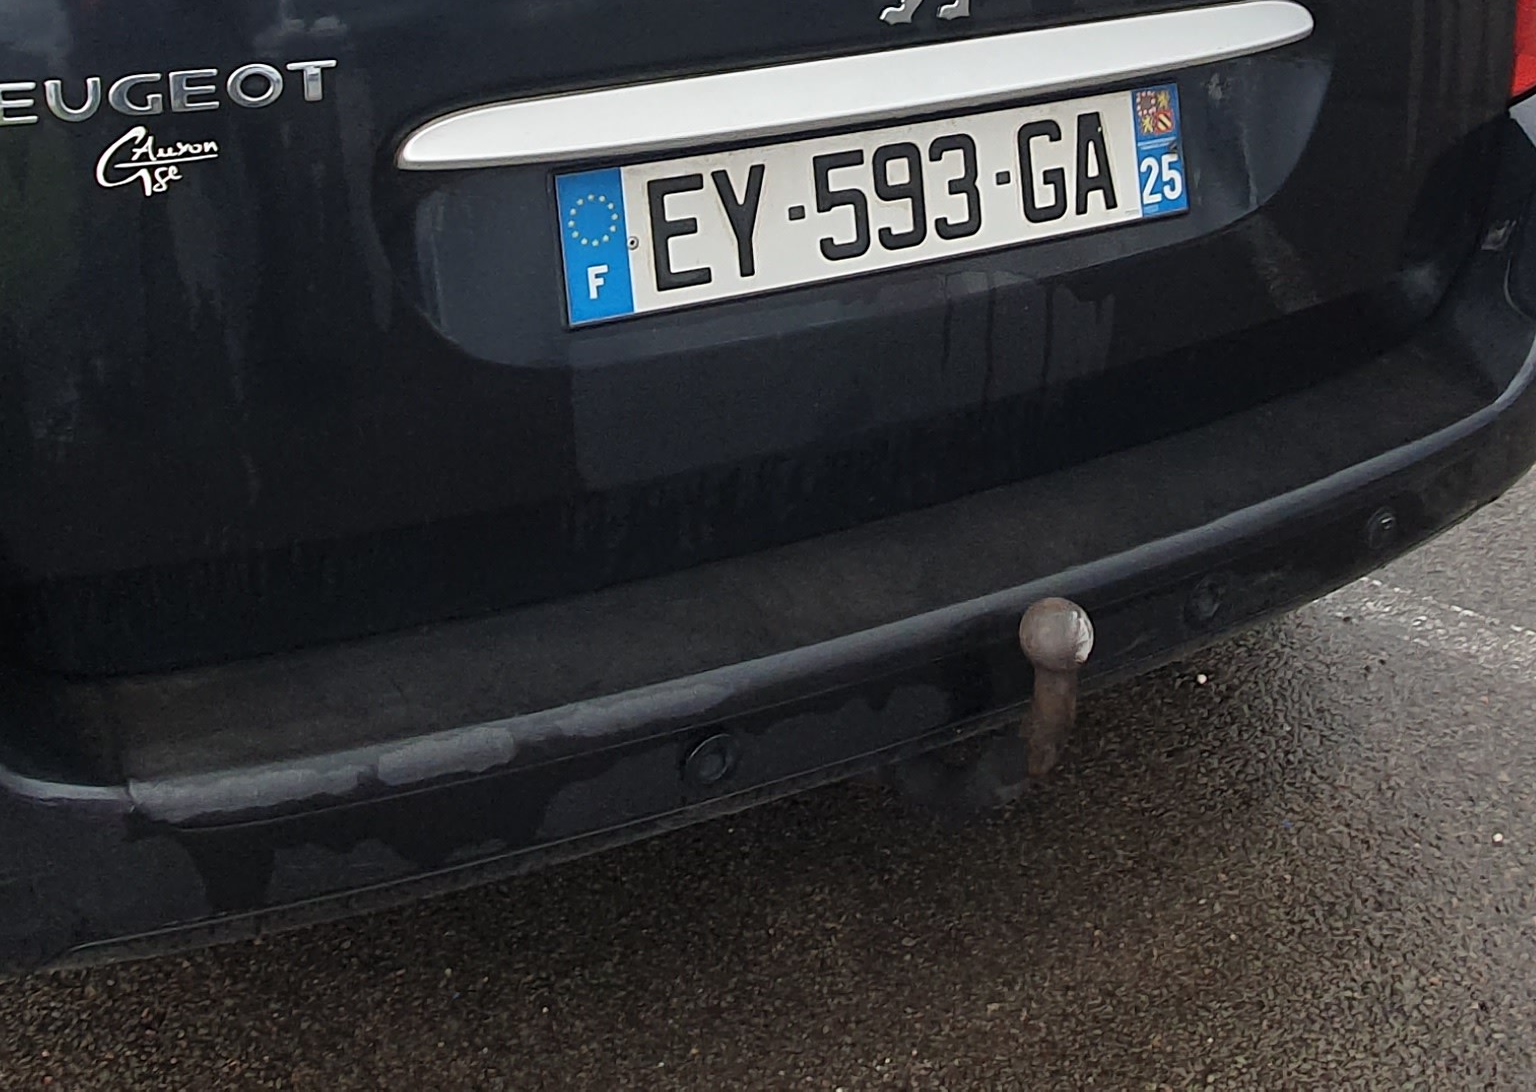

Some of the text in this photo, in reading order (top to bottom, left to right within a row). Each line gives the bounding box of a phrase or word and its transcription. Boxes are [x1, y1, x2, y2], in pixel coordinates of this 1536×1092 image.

[646, 111, 1118, 292] EY-593-GA
[1140, 153, 1183, 205] 25
[587, 264, 609, 299] F
